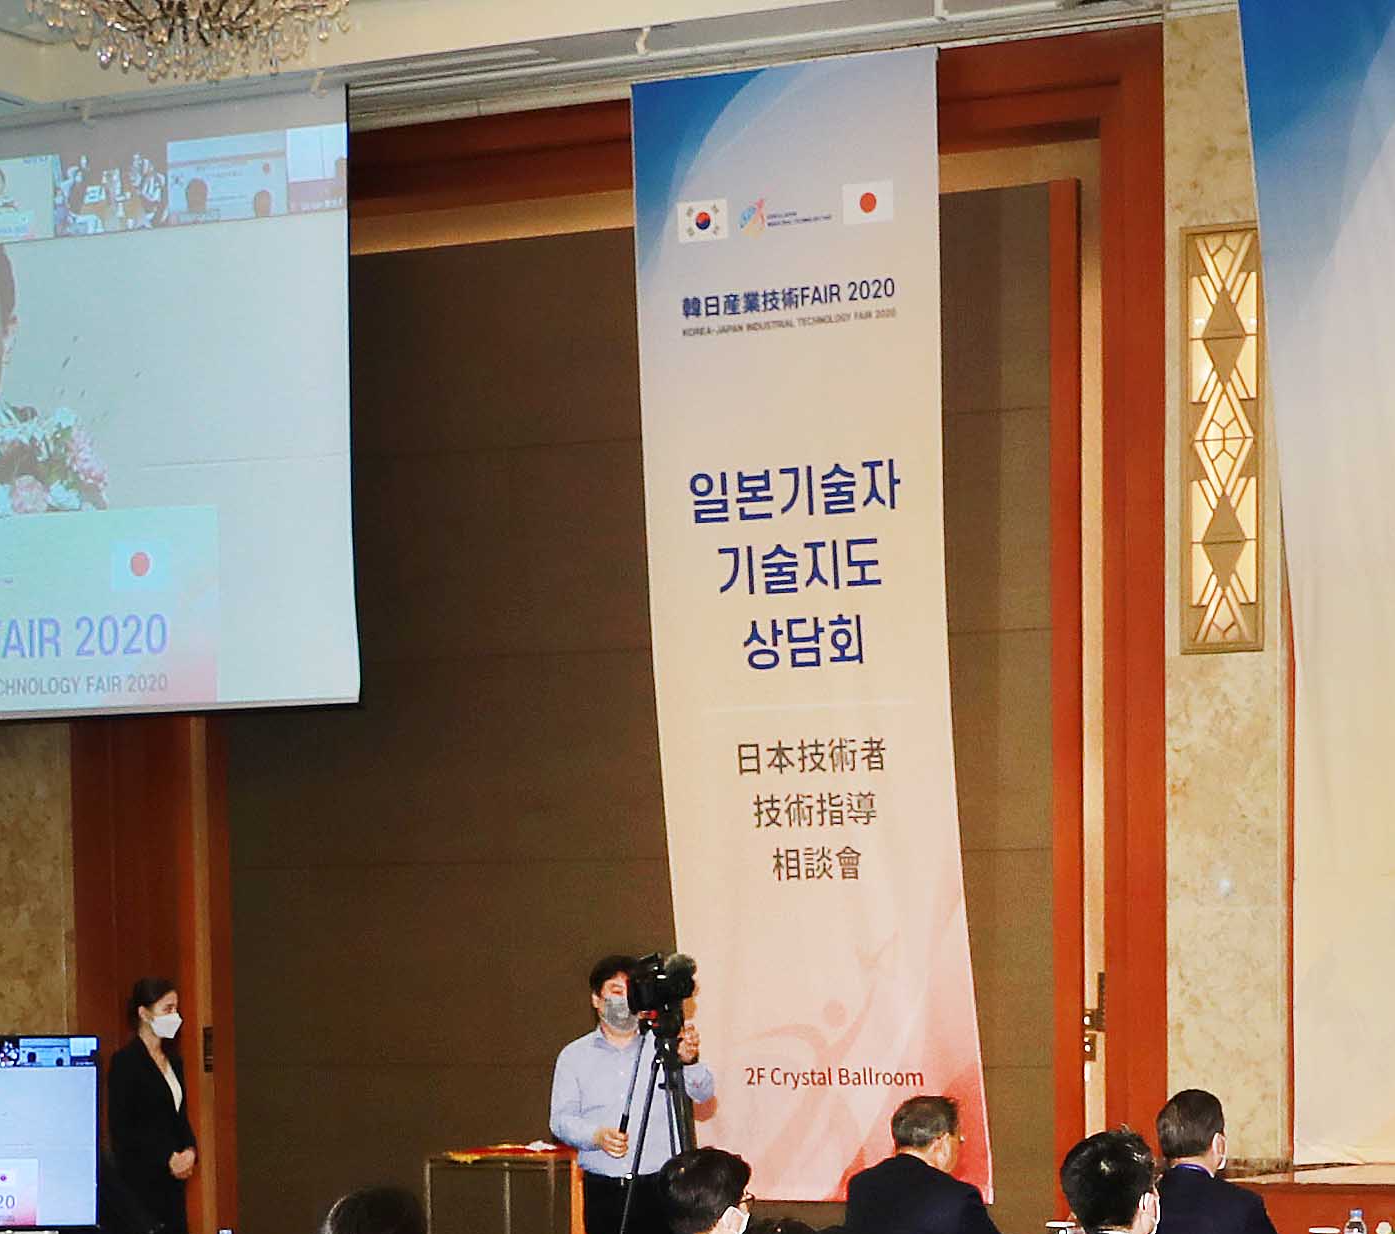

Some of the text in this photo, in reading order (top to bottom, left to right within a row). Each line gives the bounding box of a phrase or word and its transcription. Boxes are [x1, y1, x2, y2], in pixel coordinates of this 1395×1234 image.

[682, 278, 895, 319] 韓日産業技術FAIR 2020
[682, 308, 896, 336] KOREA-JAPAN INDUSTRIAL TECHNOLOGY FAIR 2020
[689, 458, 901, 524] 일본기술자
[718, 538, 883, 596] 기술지도
[76, 614, 168, 657] 2020
[743, 614, 865, 670] 상담회
[86, 675, 122, 693] FAIR
[128, 672, 168, 693] 2020
[736, 737, 886, 775] 日本技術者
[753, 792, 878, 829] 技術指導
[773, 847, 862, 881] 相談會
[746, 1069, 924, 1089] 2F Crystal Ballroom
